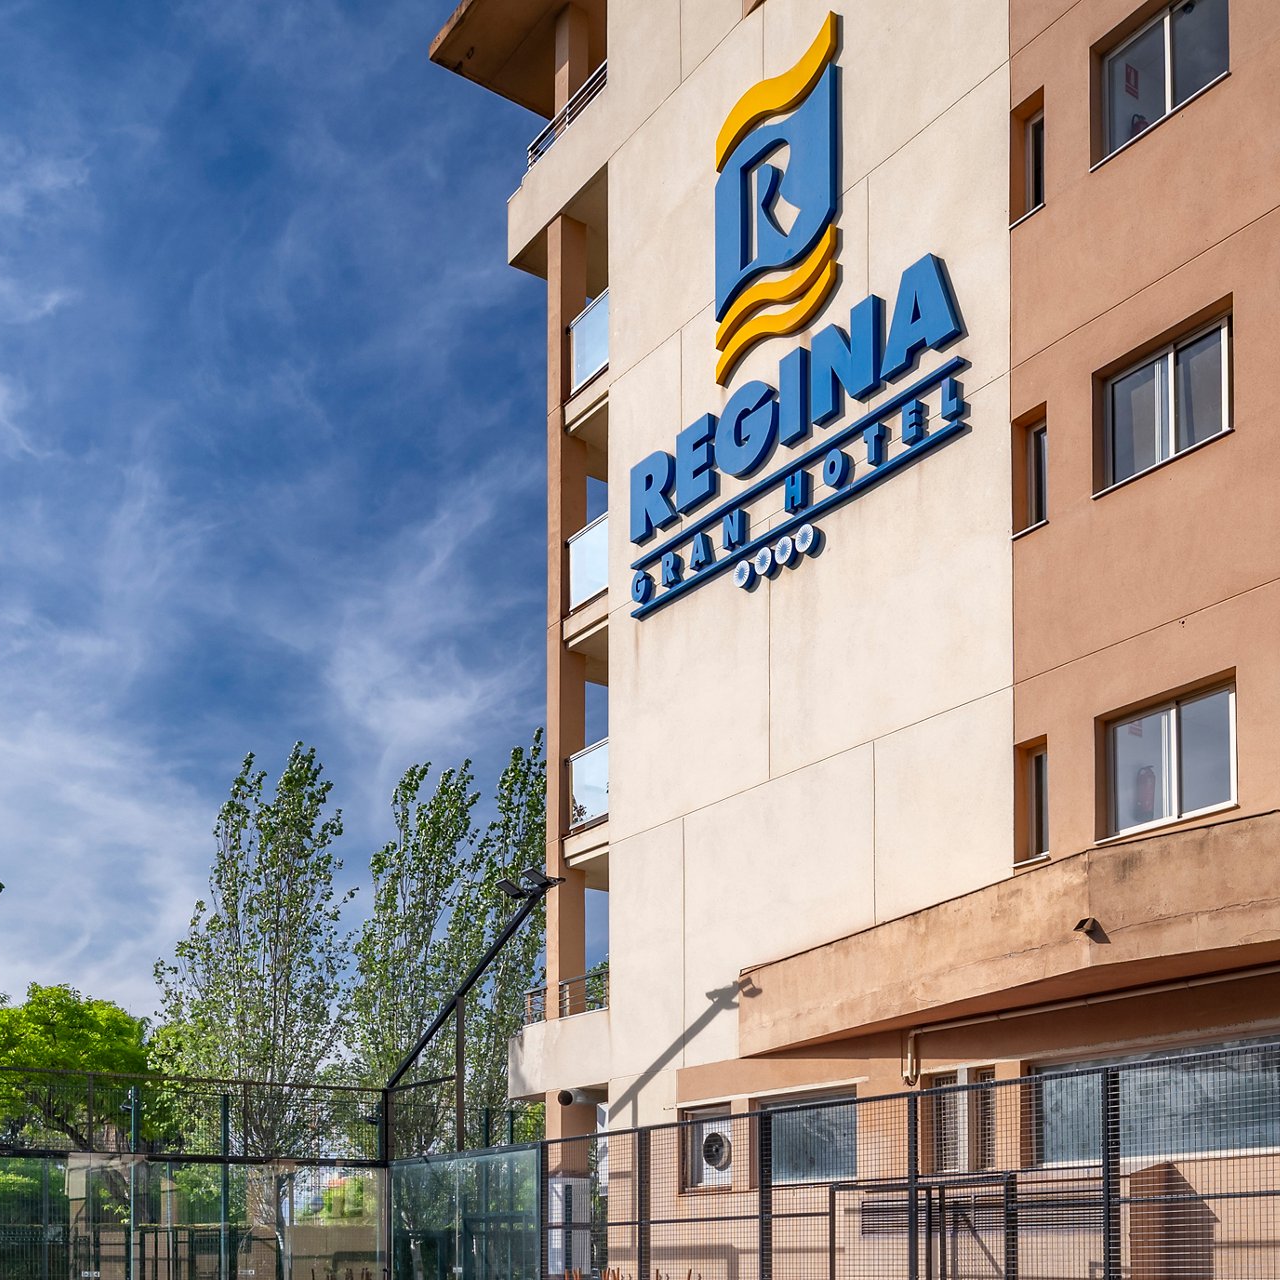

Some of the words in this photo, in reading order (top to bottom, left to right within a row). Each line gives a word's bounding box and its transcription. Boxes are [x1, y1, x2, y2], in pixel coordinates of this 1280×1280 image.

[630, 252, 963, 545] REGINA
[631, 508, 749, 604] GRAN
[784, 377, 965, 515] HOTEL
